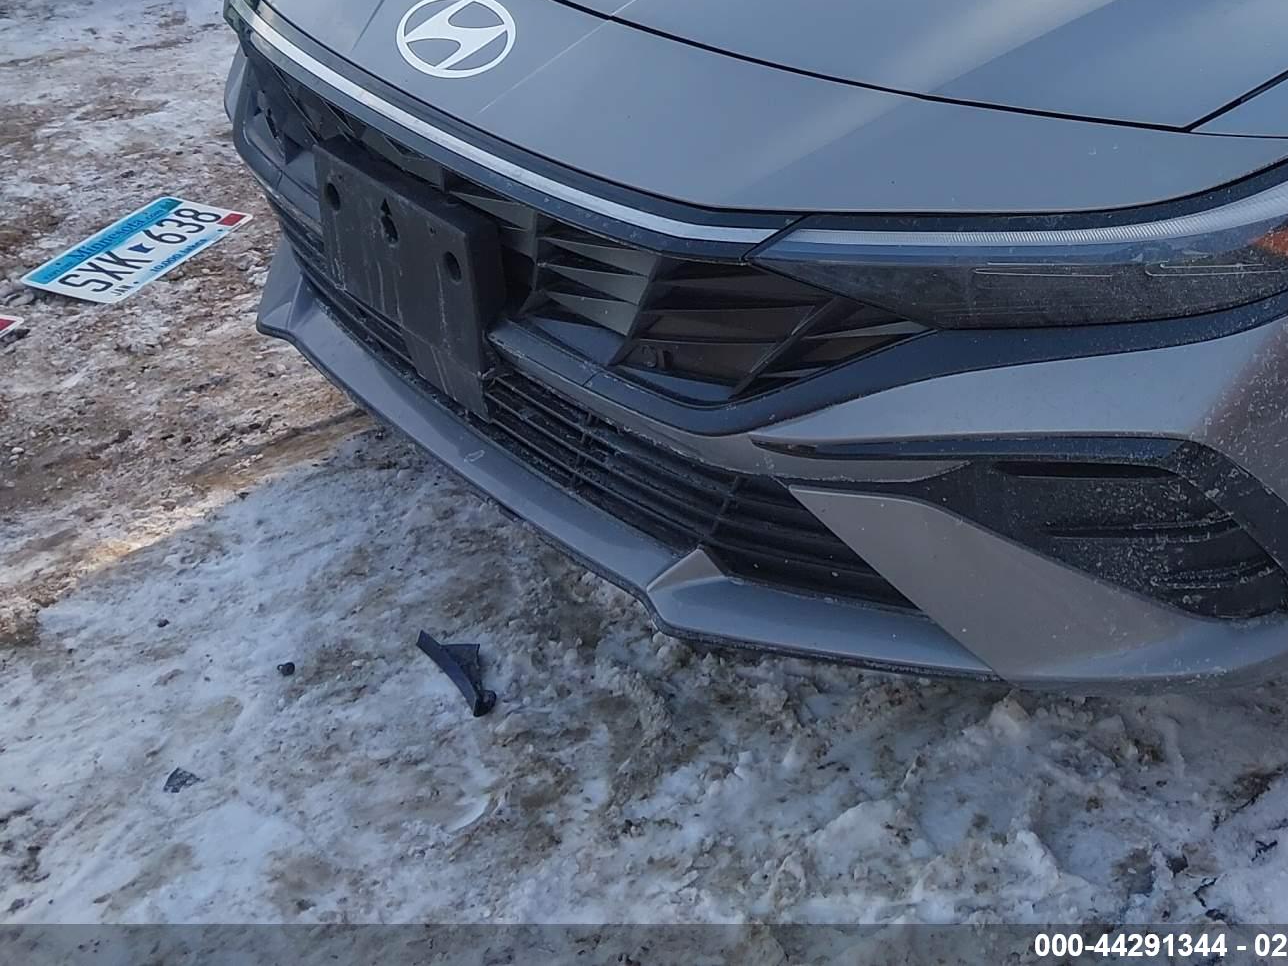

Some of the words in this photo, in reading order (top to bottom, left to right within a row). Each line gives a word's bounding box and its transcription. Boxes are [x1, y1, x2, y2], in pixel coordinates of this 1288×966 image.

[58, 251, 152, 292] SXK
[144, 208, 223, 244] 638
[73, 218, 146, 261] Minnesota
